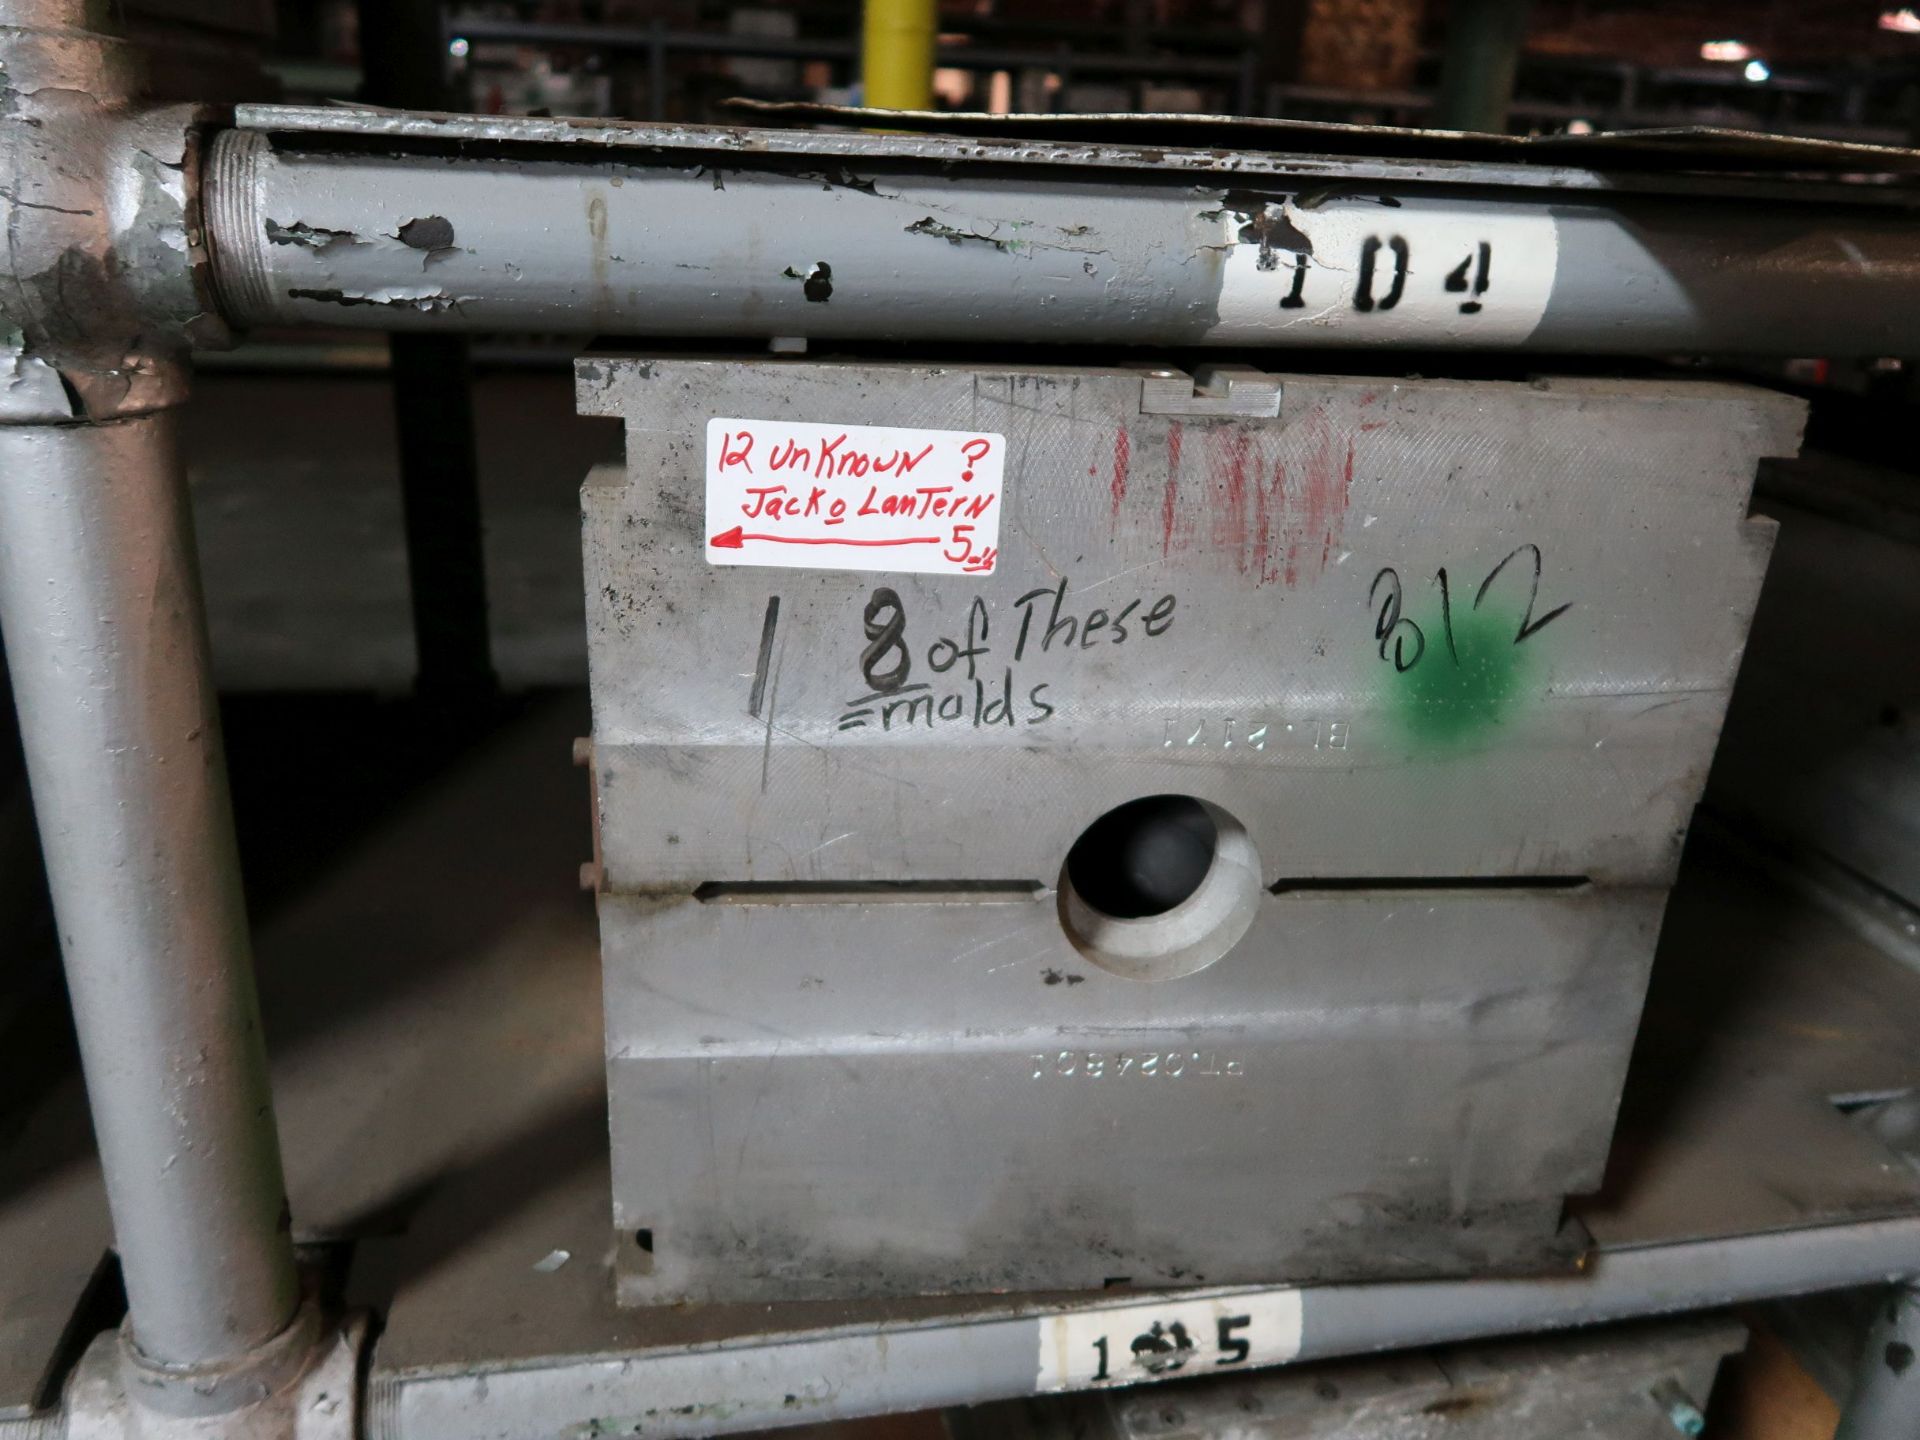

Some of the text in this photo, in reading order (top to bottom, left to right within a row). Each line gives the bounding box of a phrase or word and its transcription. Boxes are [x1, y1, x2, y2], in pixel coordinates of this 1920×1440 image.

[1279, 234, 1492, 315] 104
[718, 431, 754, 474] 12
[961, 439, 991, 482] ?
[860, 576, 1178, 693] 8 of These
[882, 667, 1054, 732] molds
